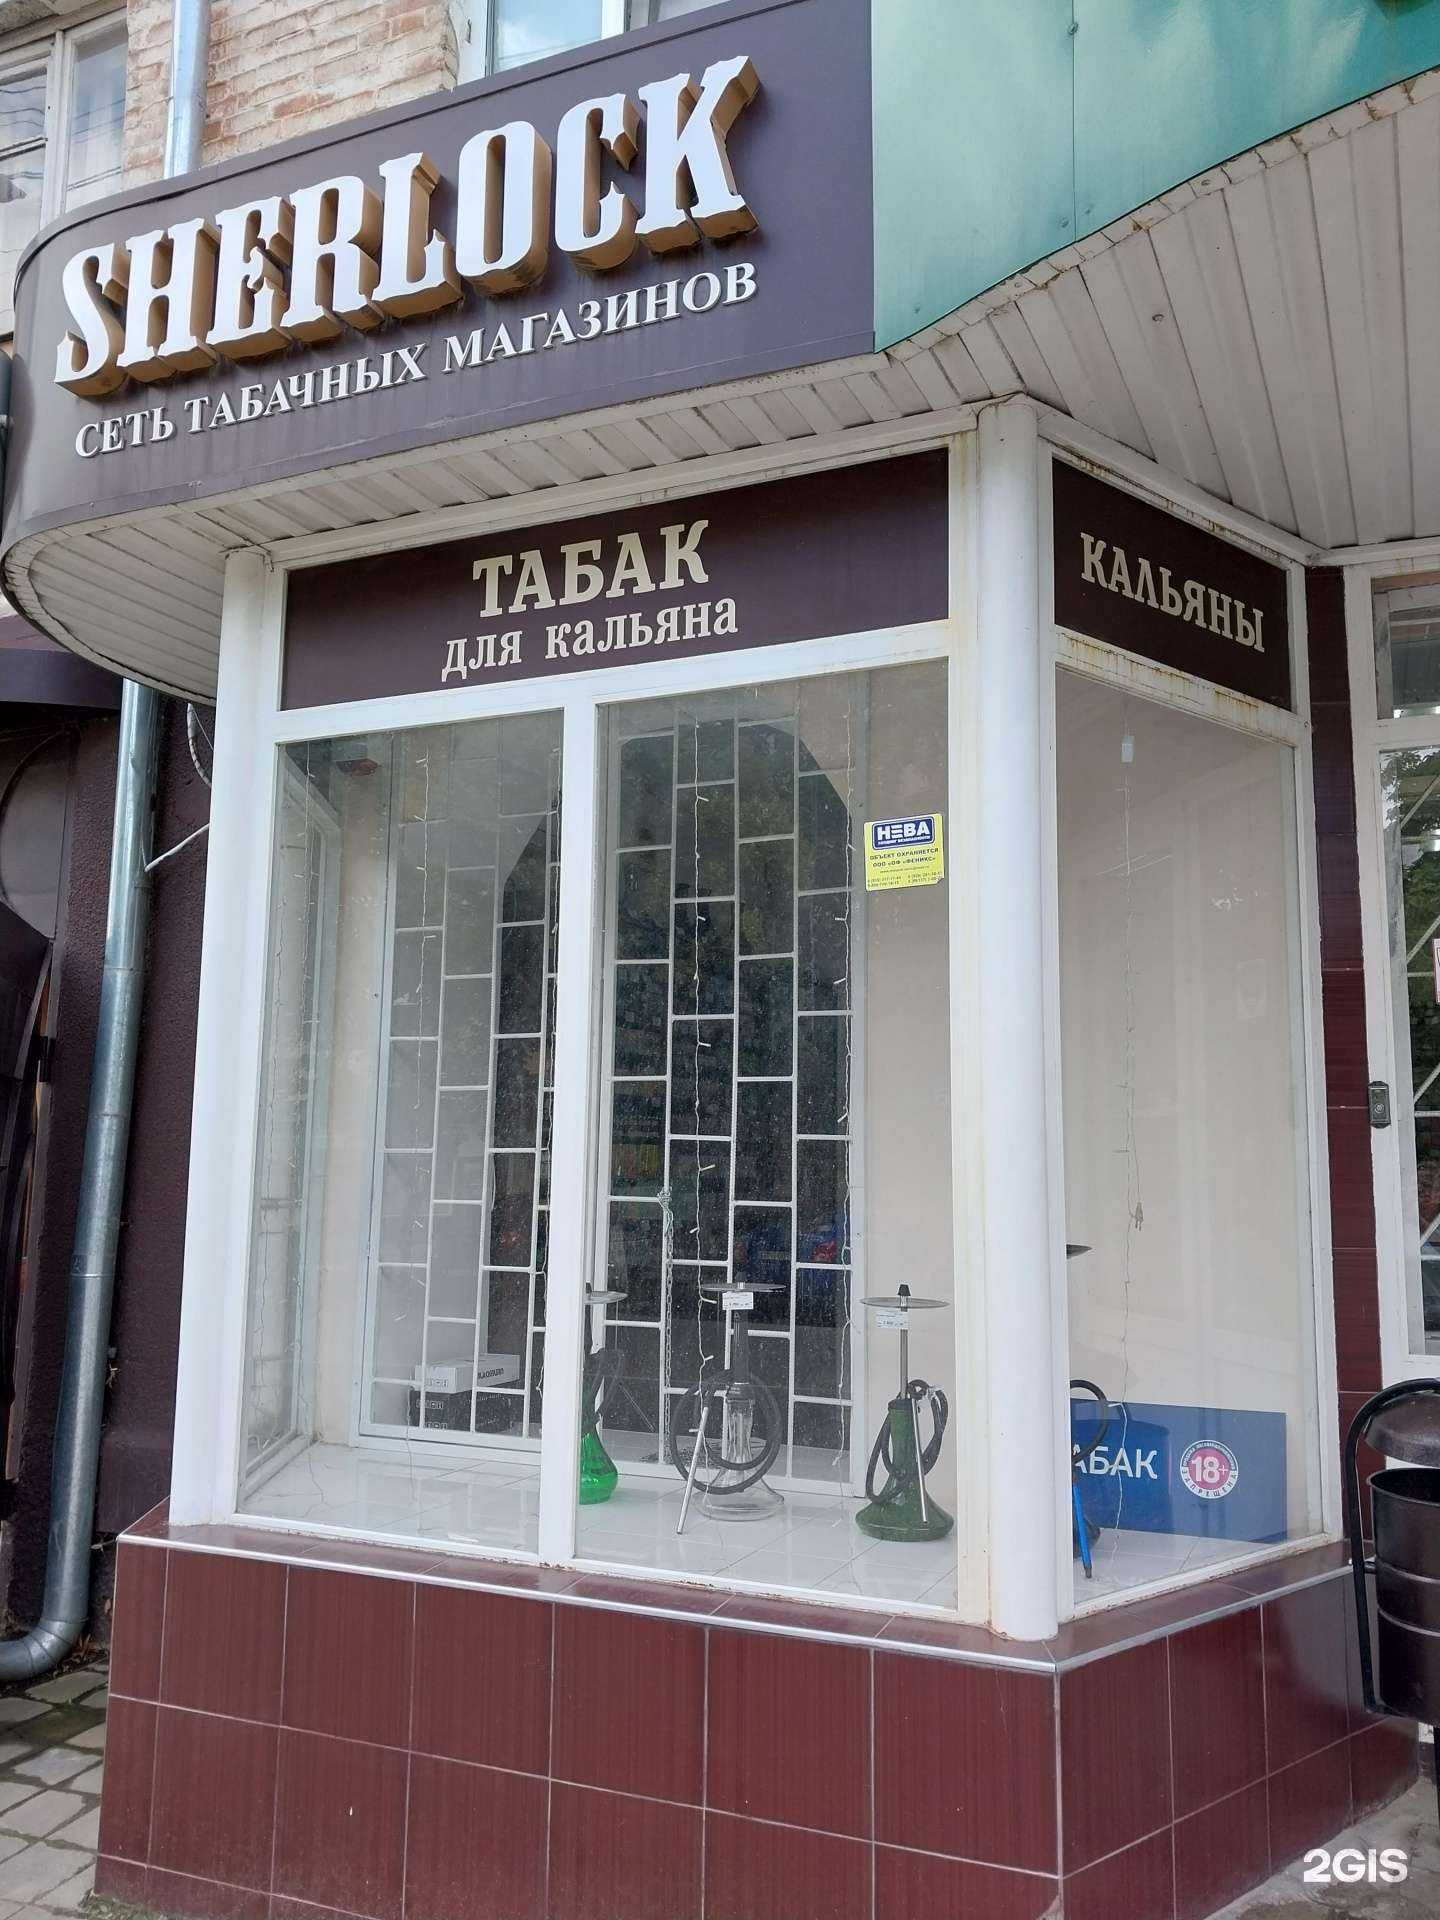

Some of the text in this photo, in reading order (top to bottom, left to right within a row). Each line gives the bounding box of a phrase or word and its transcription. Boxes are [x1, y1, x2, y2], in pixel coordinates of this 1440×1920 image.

[55, 56, 757, 392] SHERLOCK
[75, 262, 758, 459] СЕТЬ ТАБАЧНЫХ МАГАЗИНОВ
[472, 519, 709, 618] ТАБАК
[1080, 531, 1265, 653] КАЛЬЯНЫ
[441, 597, 738, 682] для кальяна
[1191, 1456, 1229, 1483] 18+
